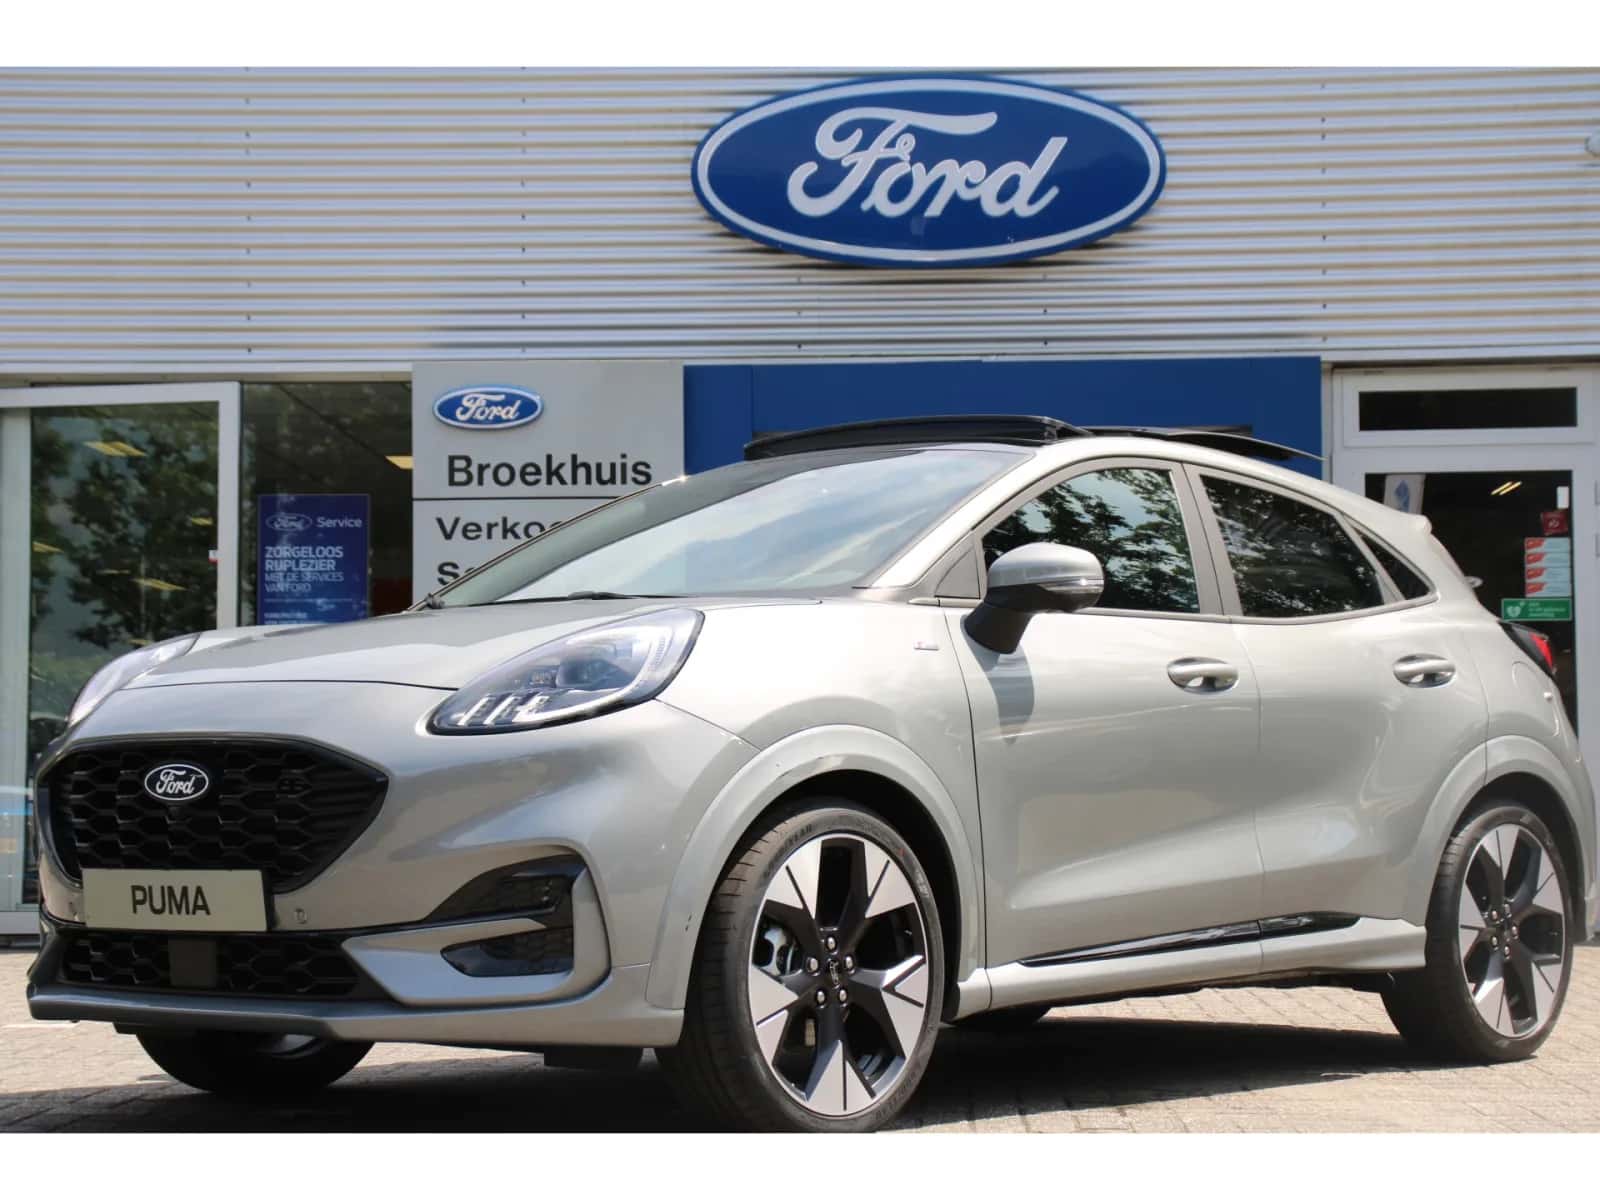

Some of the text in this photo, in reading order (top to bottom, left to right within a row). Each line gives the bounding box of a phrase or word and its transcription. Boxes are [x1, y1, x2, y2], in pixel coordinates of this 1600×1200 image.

[787, 107, 1068, 217] Ford
[455, 392, 520, 421] Ford
[447, 453, 653, 486] Broekhuis
[316, 516, 363, 528] Service
[435, 516, 562, 540] Verko
[264, 546, 344, 558] ZORGELOOS
[156, 769, 196, 794] Ford
[130, 884, 211, 916] PUMA
